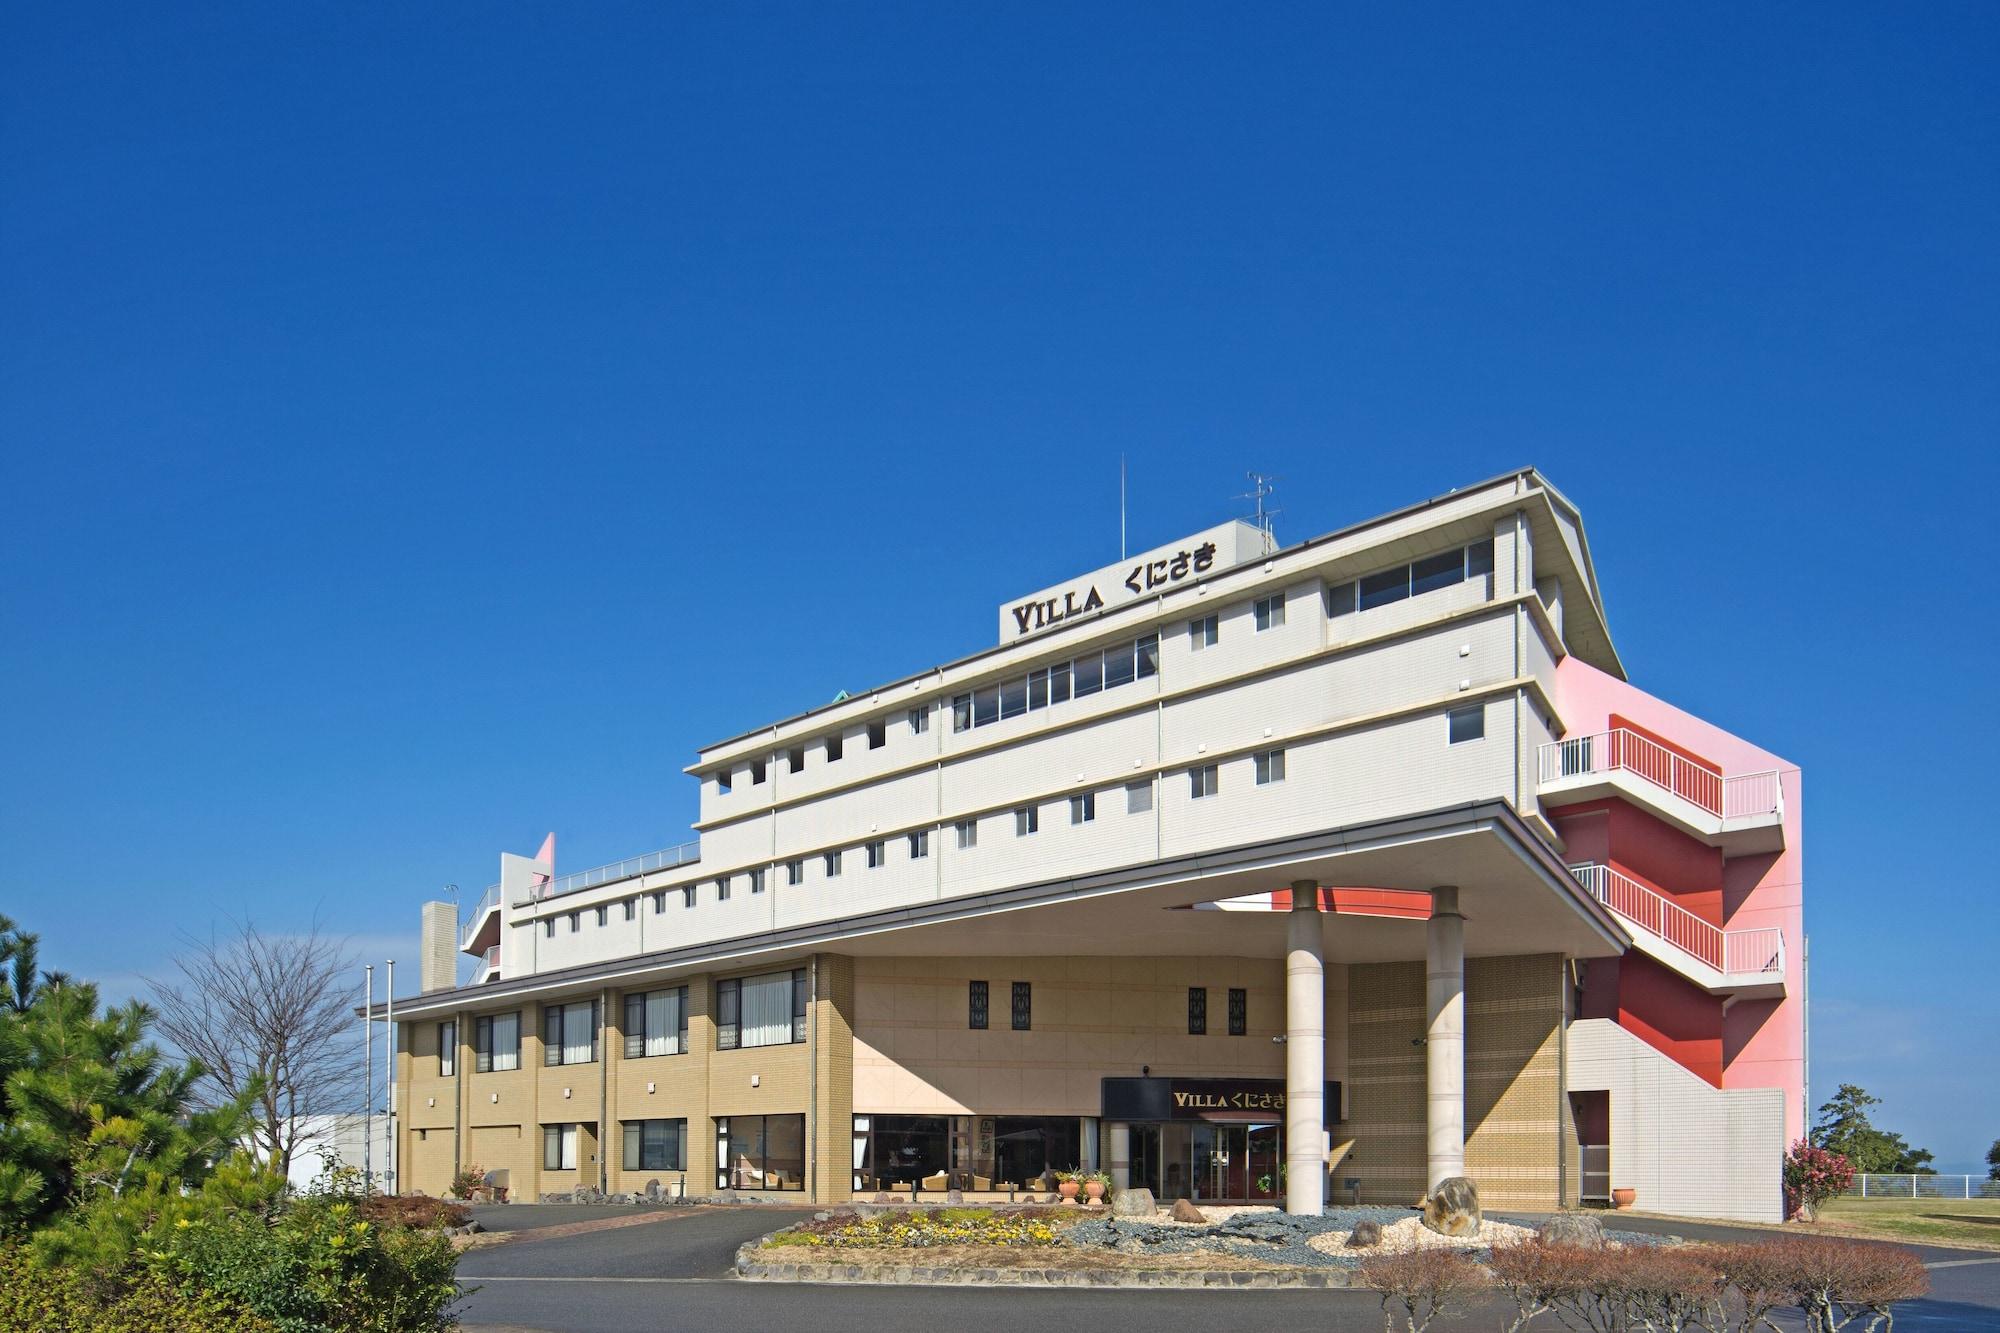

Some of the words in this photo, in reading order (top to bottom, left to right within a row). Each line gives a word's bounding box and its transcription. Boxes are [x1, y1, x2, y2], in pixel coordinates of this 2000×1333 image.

[1012, 585, 1104, 634] VILLA
[1125, 542, 1216, 593] くにさき
[1174, 1092, 1228, 1107] VILLA
[1231, 1092, 1286, 1109] くにさき
